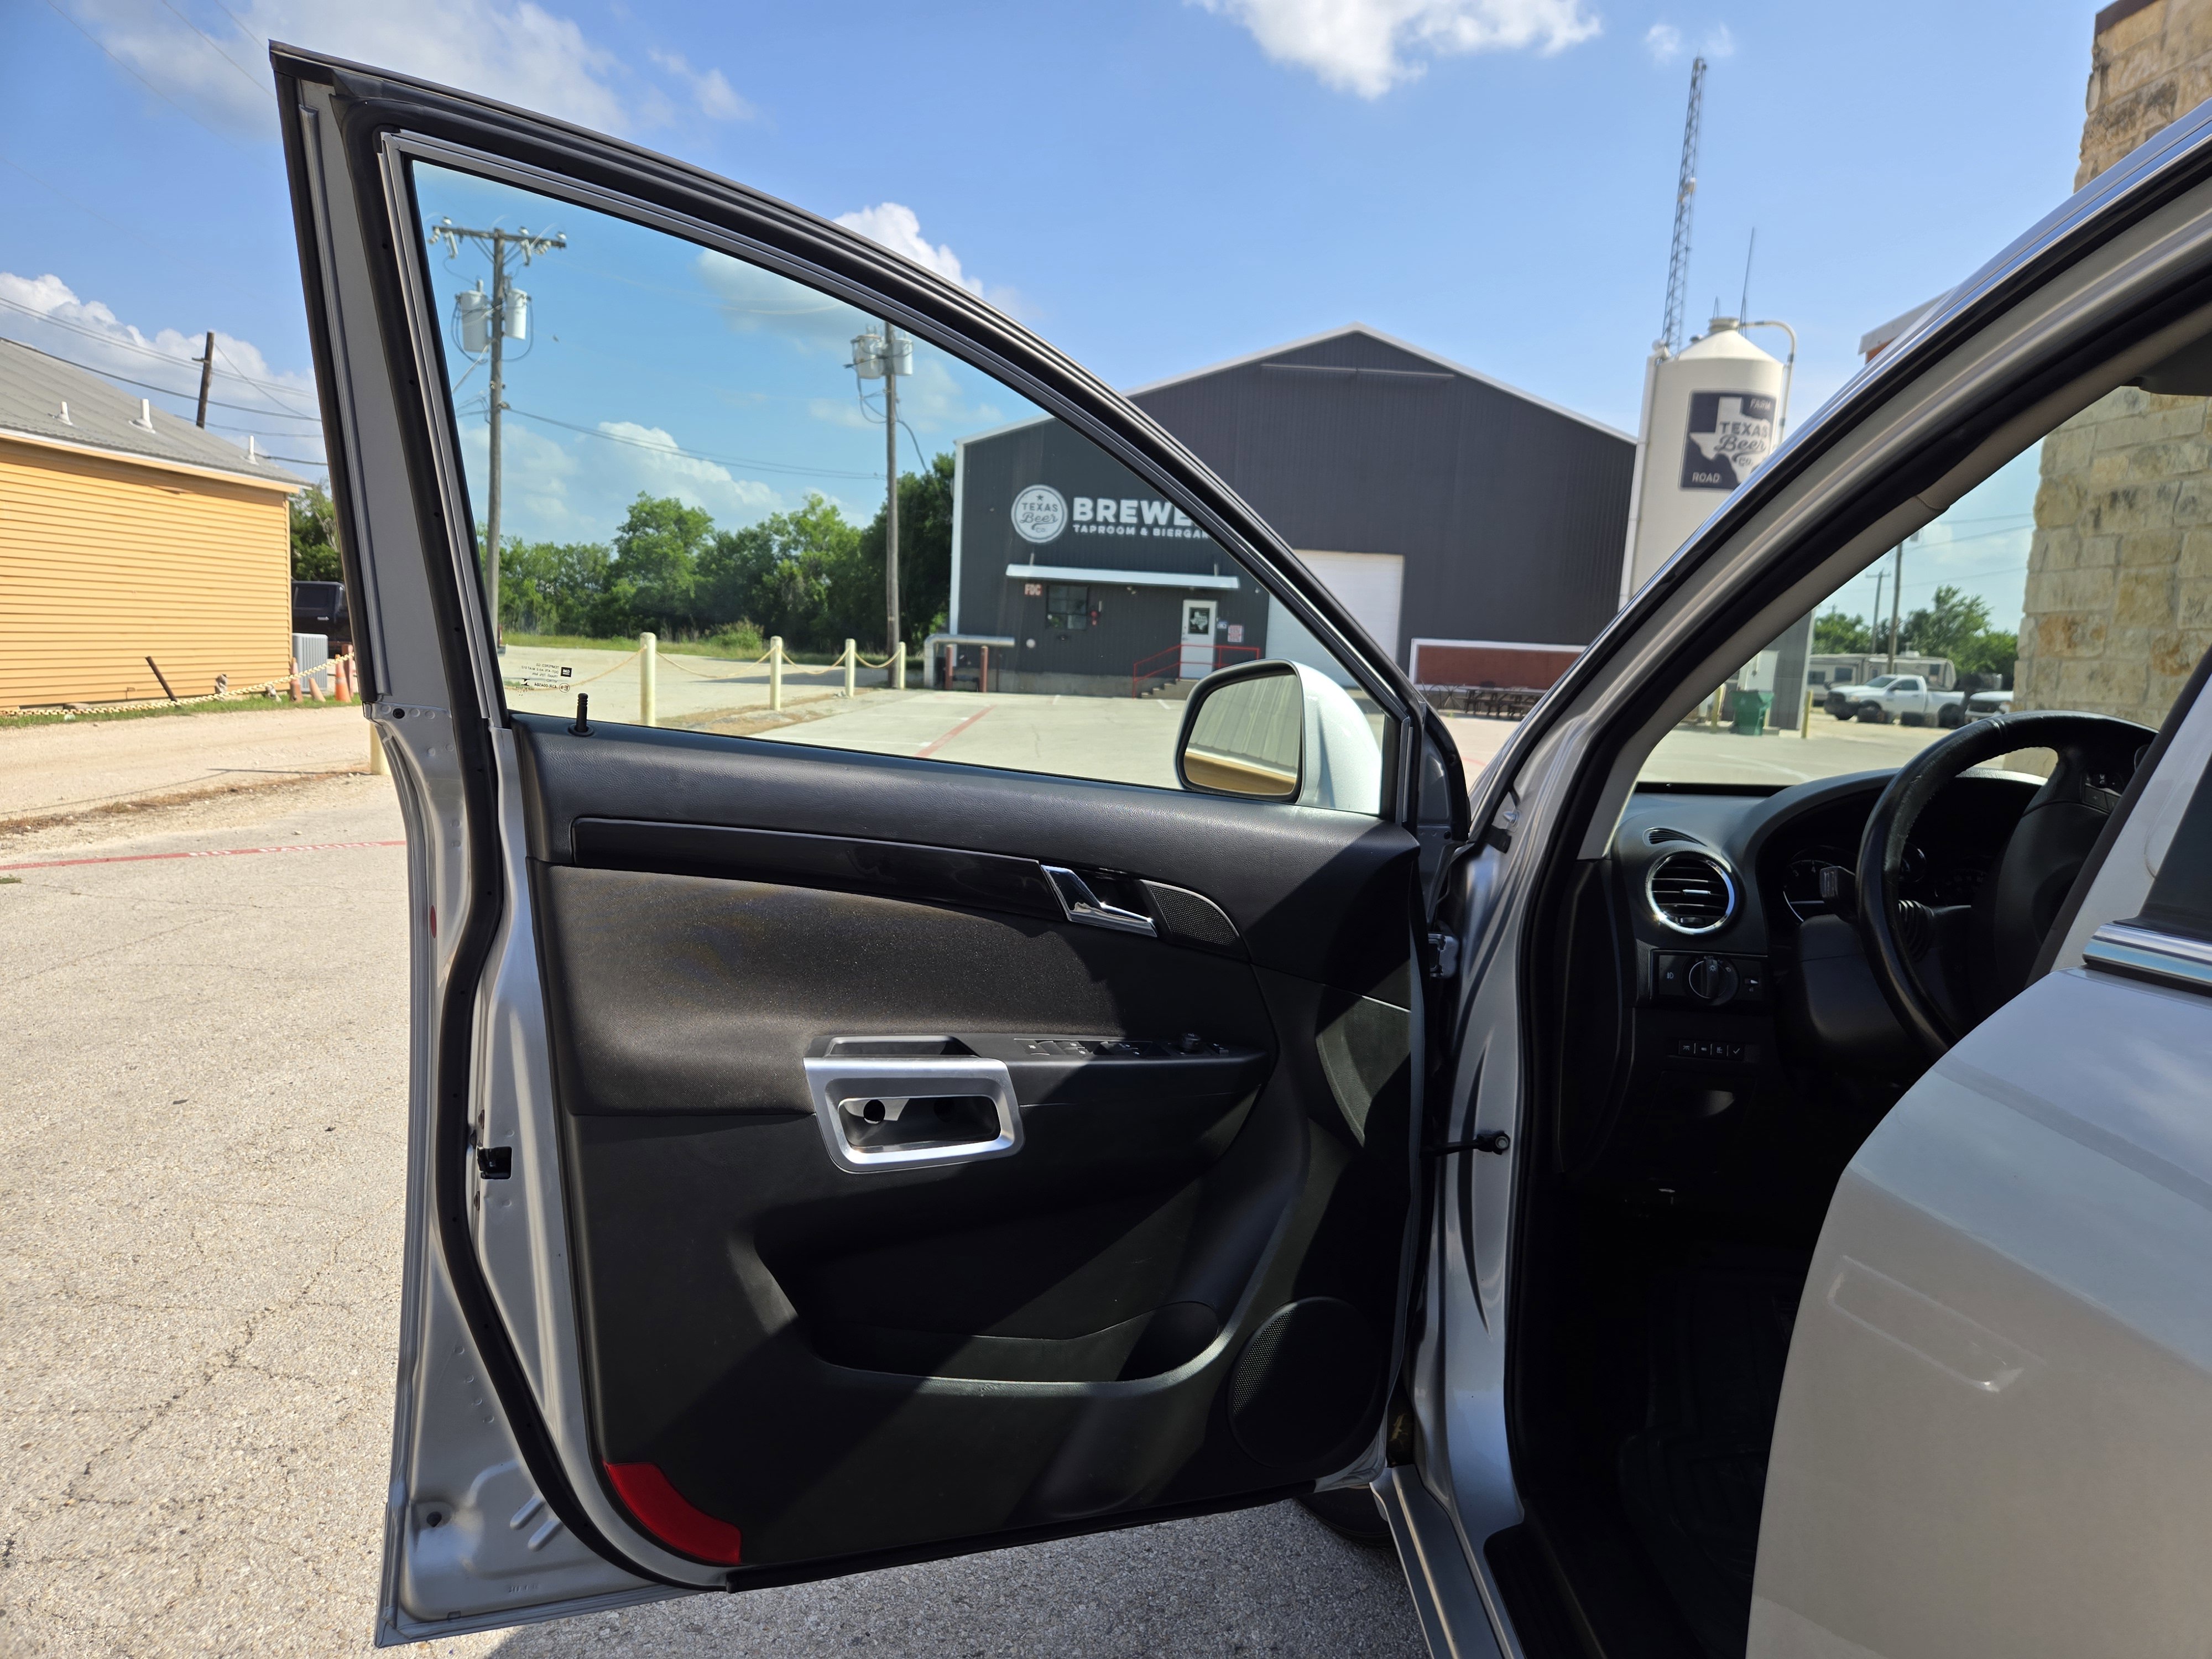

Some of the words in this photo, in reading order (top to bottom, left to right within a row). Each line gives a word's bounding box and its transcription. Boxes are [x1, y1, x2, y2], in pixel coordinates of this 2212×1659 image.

[1720, 421, 1768, 437] TEXAS
[1713, 434, 1766, 459] Beer
[1692, 472, 1720, 483] ROAD
[1021, 503, 1058, 512] TEXAS
[1073, 497, 1193, 526] BREWE
[1020, 512, 1058, 528] Beer
[1073, 525, 1136, 536] TAPROOM
[1140, 528, 1148, 536] &
